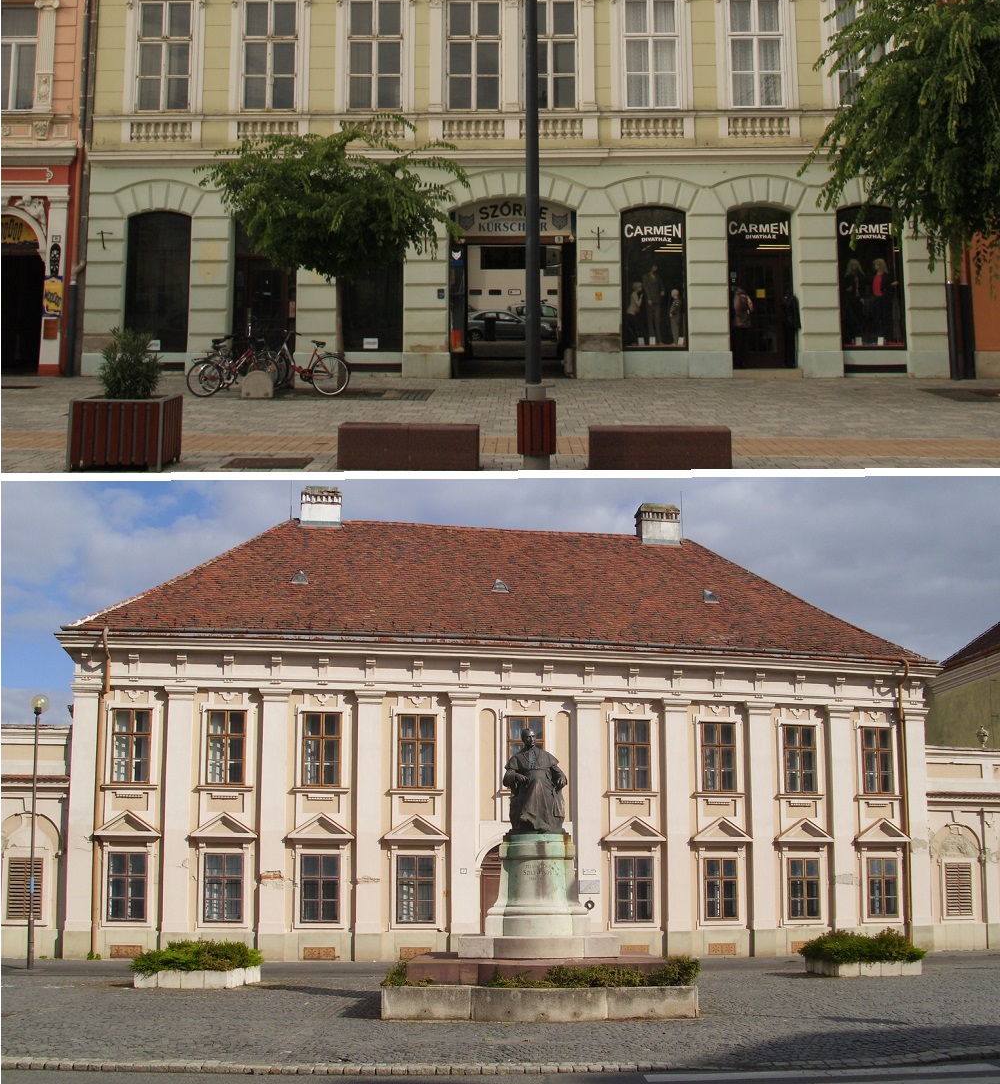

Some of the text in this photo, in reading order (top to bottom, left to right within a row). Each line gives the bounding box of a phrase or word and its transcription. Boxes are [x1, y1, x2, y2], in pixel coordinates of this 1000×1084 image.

[478, 200, 548, 220] SZŐRE
[478, 221, 548, 232] KÜRSCHR
[624, 222, 682, 239] CARMEN
[728, 220, 789, 236] CARMEN
